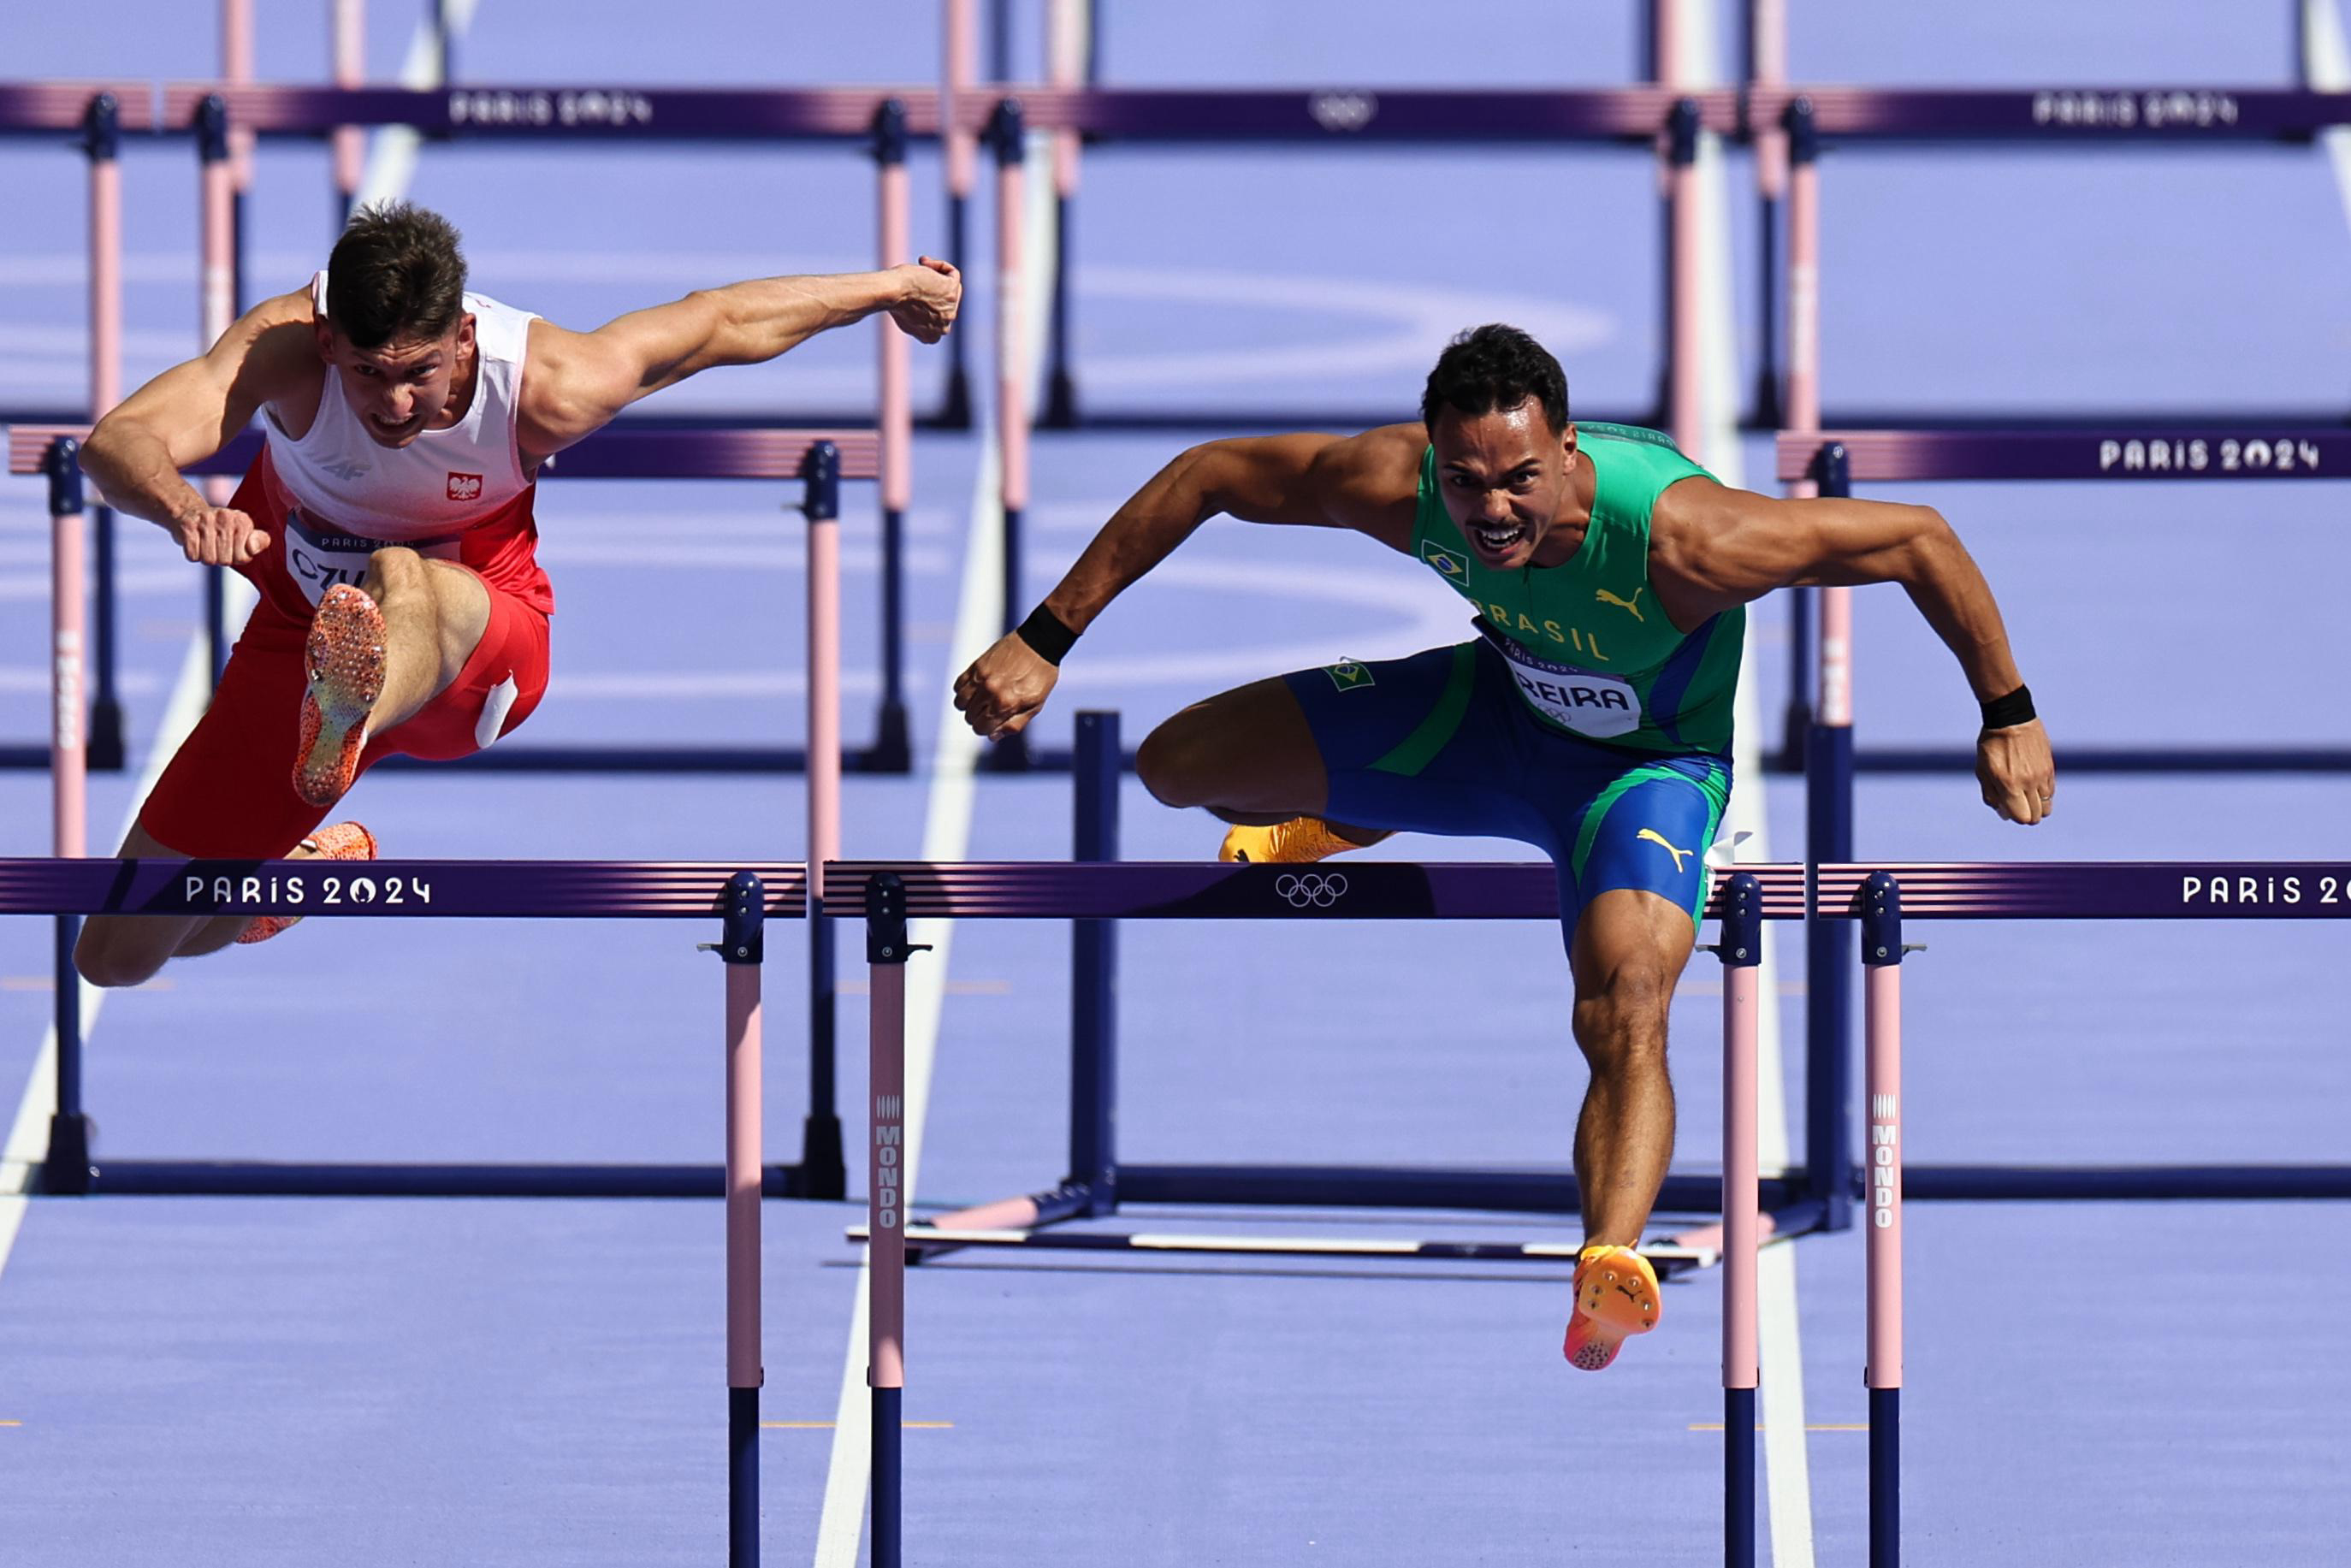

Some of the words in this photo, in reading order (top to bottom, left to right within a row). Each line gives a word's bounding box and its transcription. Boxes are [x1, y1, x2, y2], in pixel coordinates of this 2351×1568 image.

[2220, 438, 2319, 470] 2024
[322, 538, 367, 547] PARIS
[323, 877, 430, 903] 2024
[2319, 877, 2351, 903] 2
[876, 1126, 900, 1228] MONDO
[1872, 1125, 1897, 1228] MONDO
